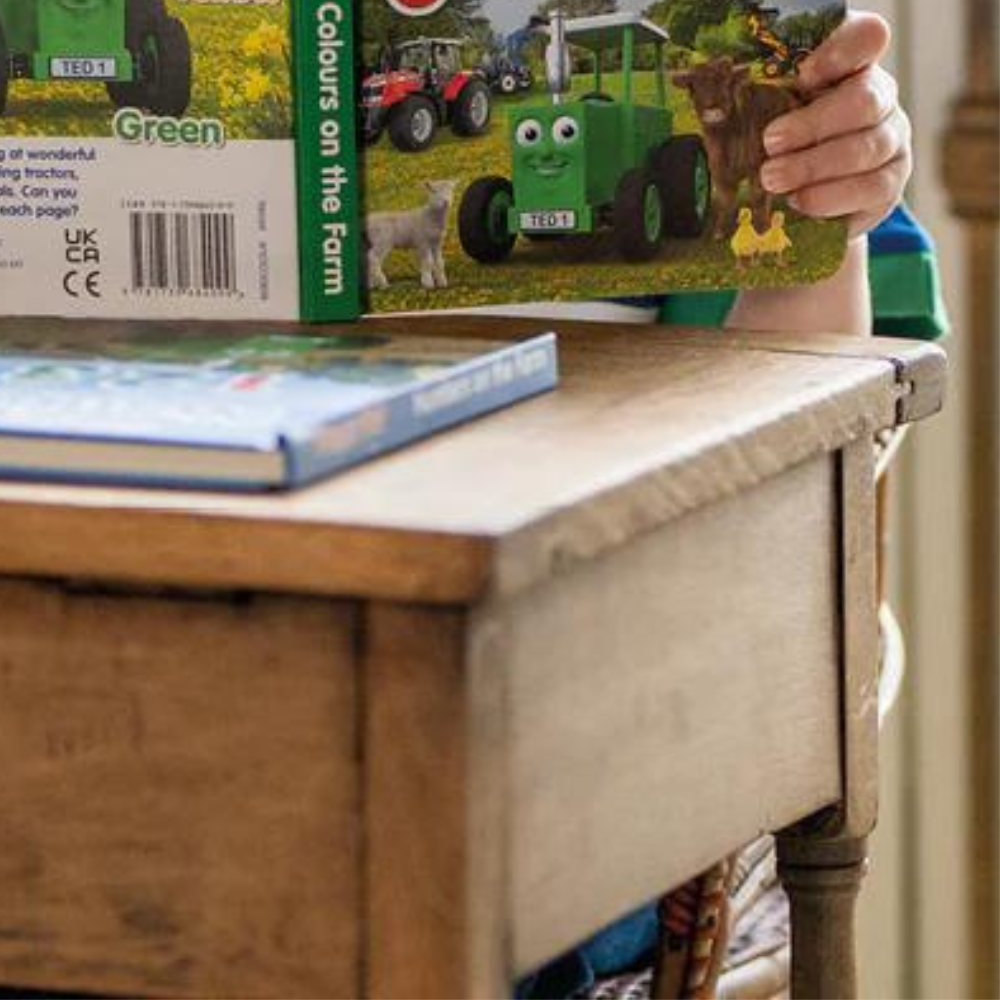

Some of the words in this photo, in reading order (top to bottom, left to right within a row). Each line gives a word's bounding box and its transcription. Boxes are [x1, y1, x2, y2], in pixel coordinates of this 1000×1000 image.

[317, 2, 344, 110] Colours
[60, 61, 94, 74] TED
[98, 61, 105, 74] 1
[113, 107, 224, 146] Green
[319, 119, 340, 156] on
[9, 148, 23, 160] at
[27, 147, 96, 160] wonderful
[25, 168, 79, 181] tractors,
[22, 185, 50, 198] Can
[53, 188, 78, 200] you
[321, 165, 348, 213] the
[0, 205, 33, 216] each
[36, 205, 79, 219] page?
[529, 214, 555, 227] TED
[65, 228, 97, 245] UK
[65, 247, 99, 263] CA
[322, 223, 347, 296] Farm
